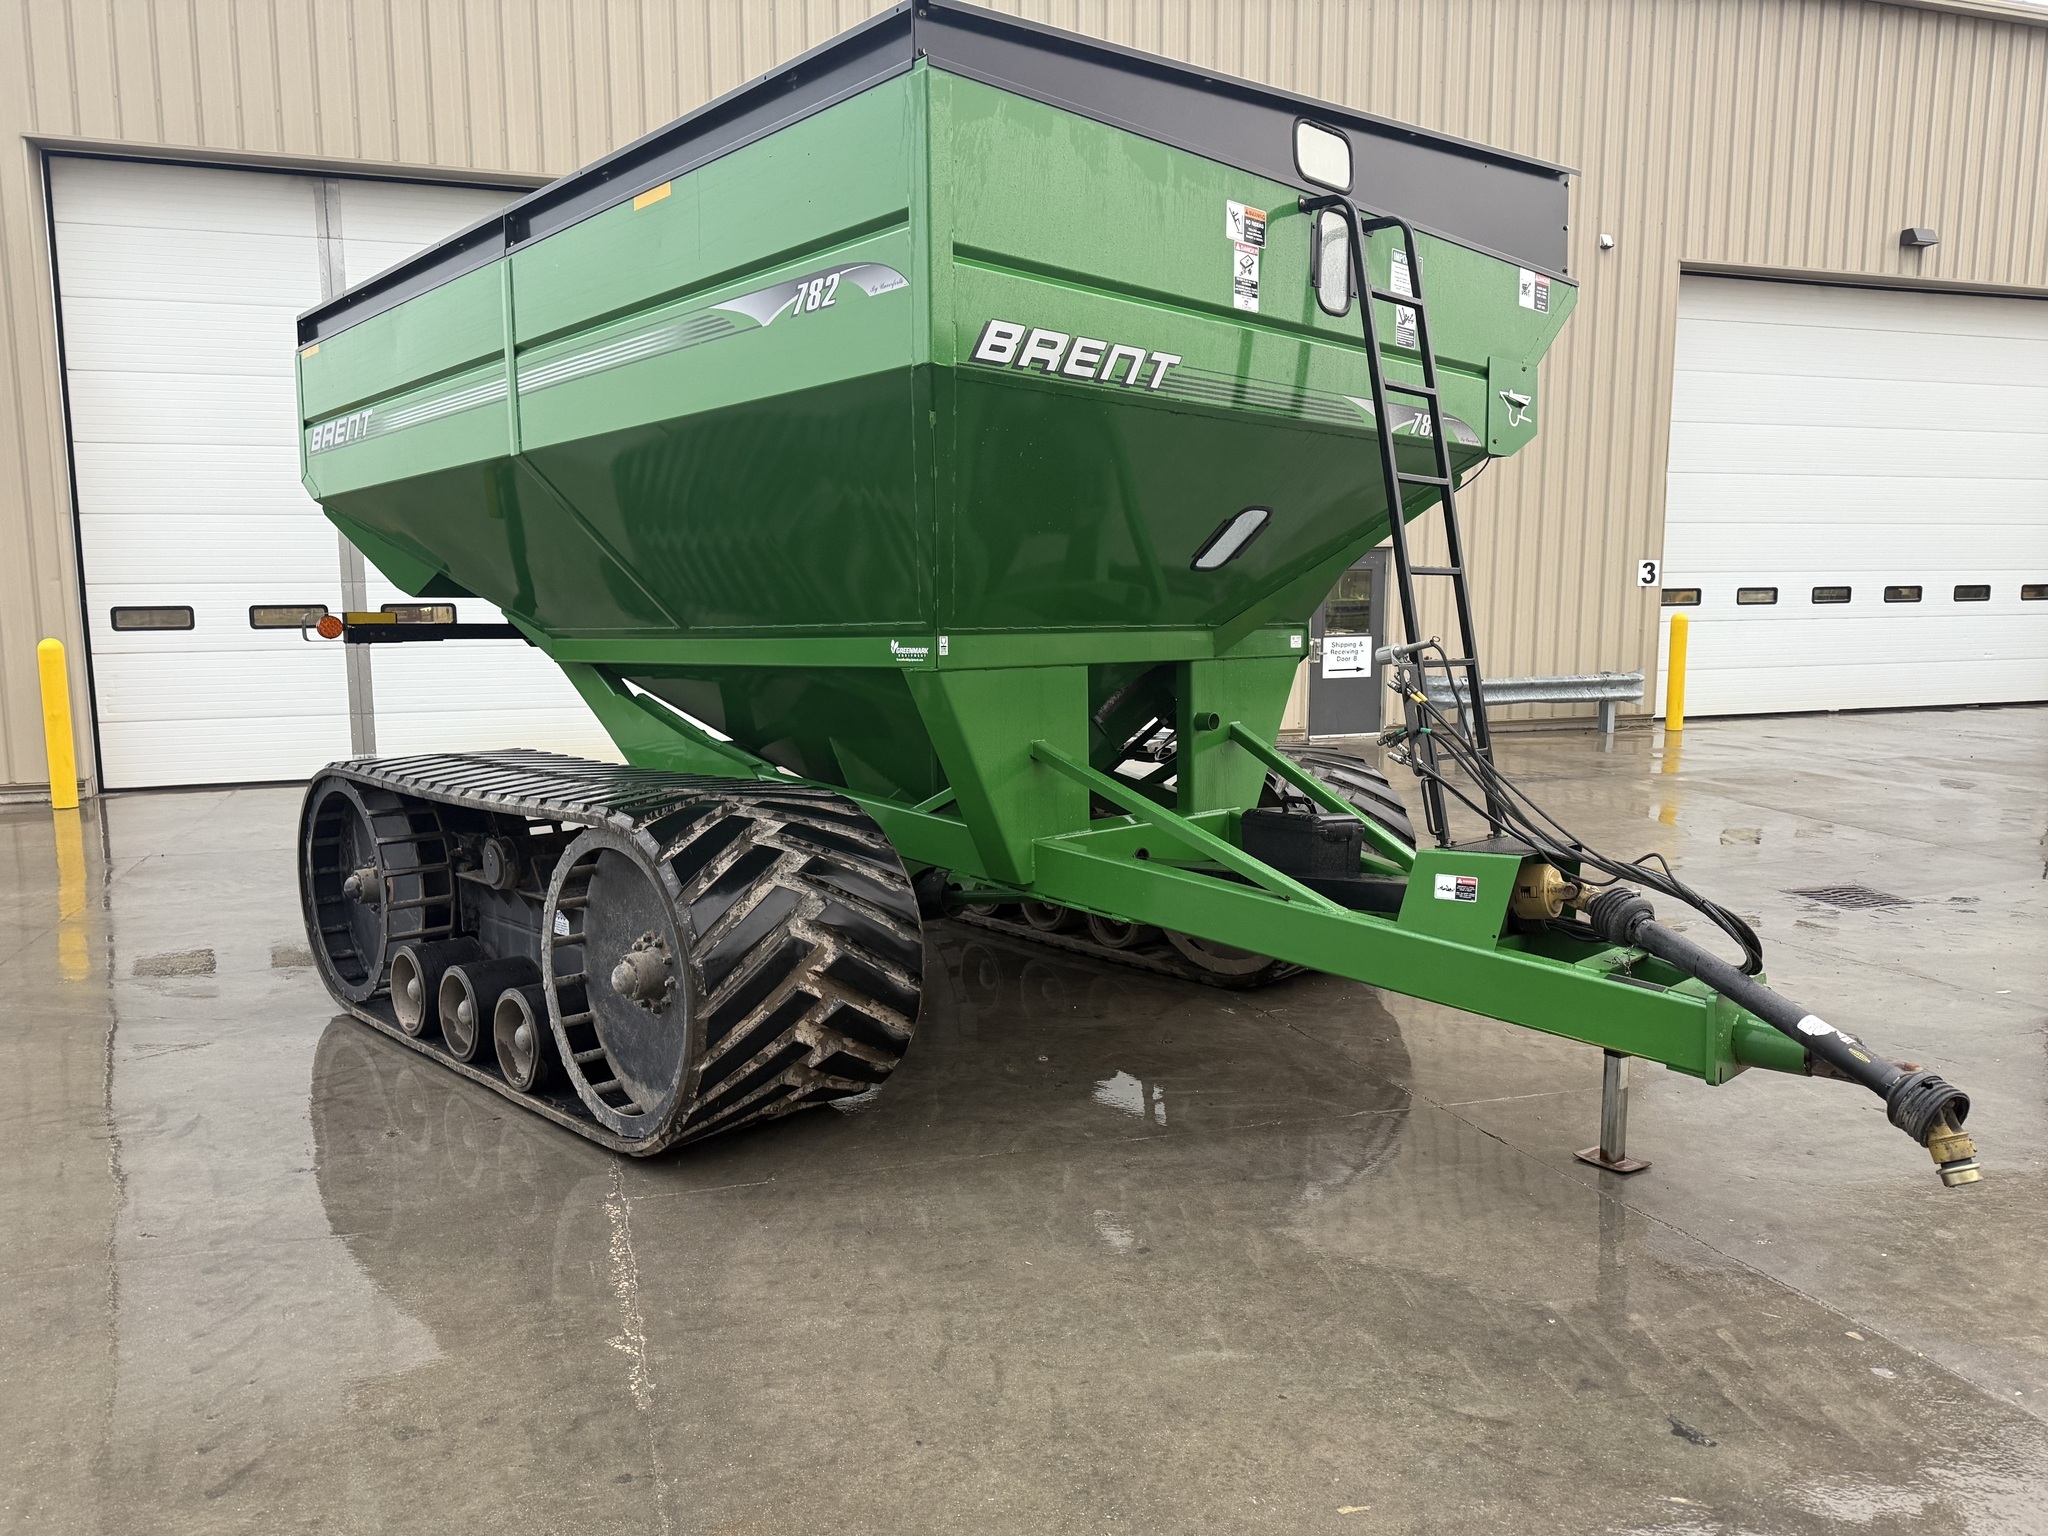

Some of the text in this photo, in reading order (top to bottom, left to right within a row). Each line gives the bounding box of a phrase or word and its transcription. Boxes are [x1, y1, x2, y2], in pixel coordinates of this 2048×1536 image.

[791, 272, 840, 318] 782
[968, 318, 1183, 391] BRENT
[310, 408, 374, 453] BRENT
[1409, 412, 1434, 437] 78
[1641, 561, 1656, 584] 3
